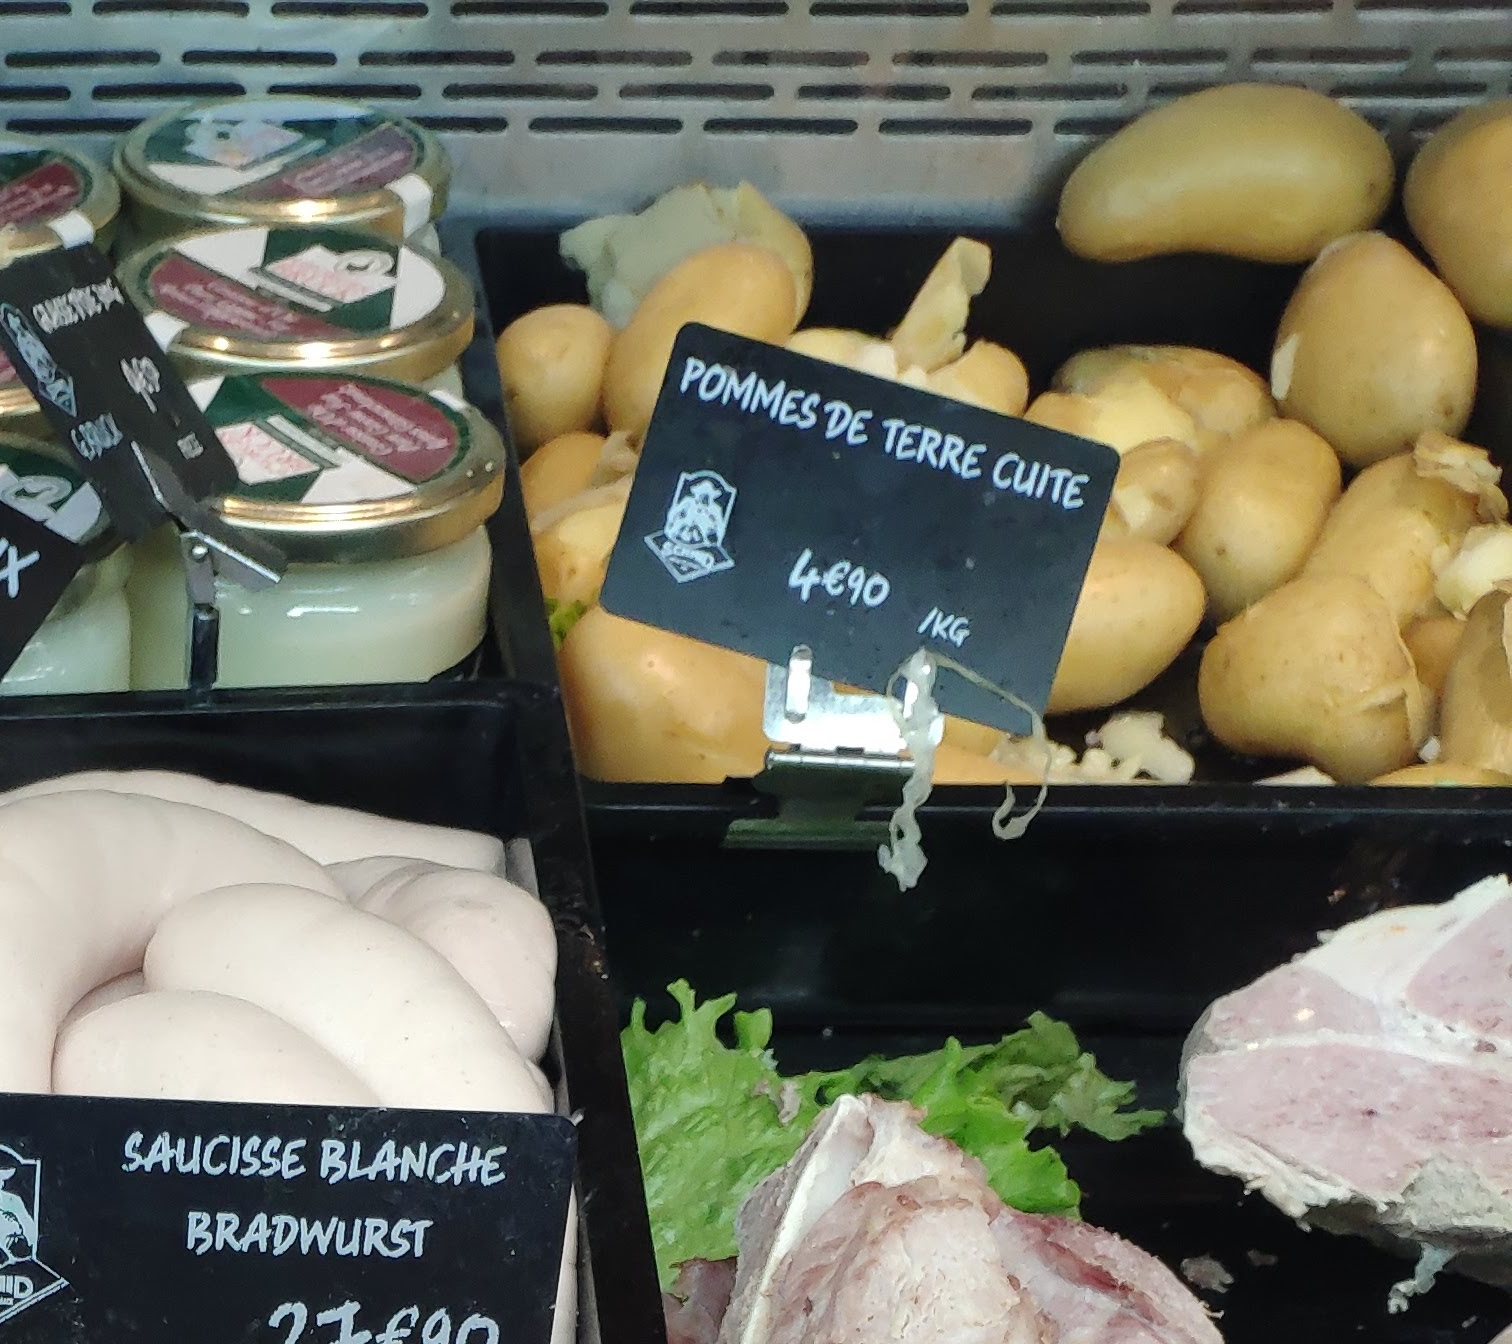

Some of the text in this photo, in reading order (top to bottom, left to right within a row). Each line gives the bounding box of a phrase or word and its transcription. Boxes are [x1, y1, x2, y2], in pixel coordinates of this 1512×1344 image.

[681, 356, 1090, 510] POMMES DE TERRE CUITE
[788, 548, 890, 607] 4€90
[917, 607, 971, 648] /KG
[121, 1130, 508, 1187] SAUCISSE BLANCHE
[186, 1211, 435, 1259] BRADWURST
